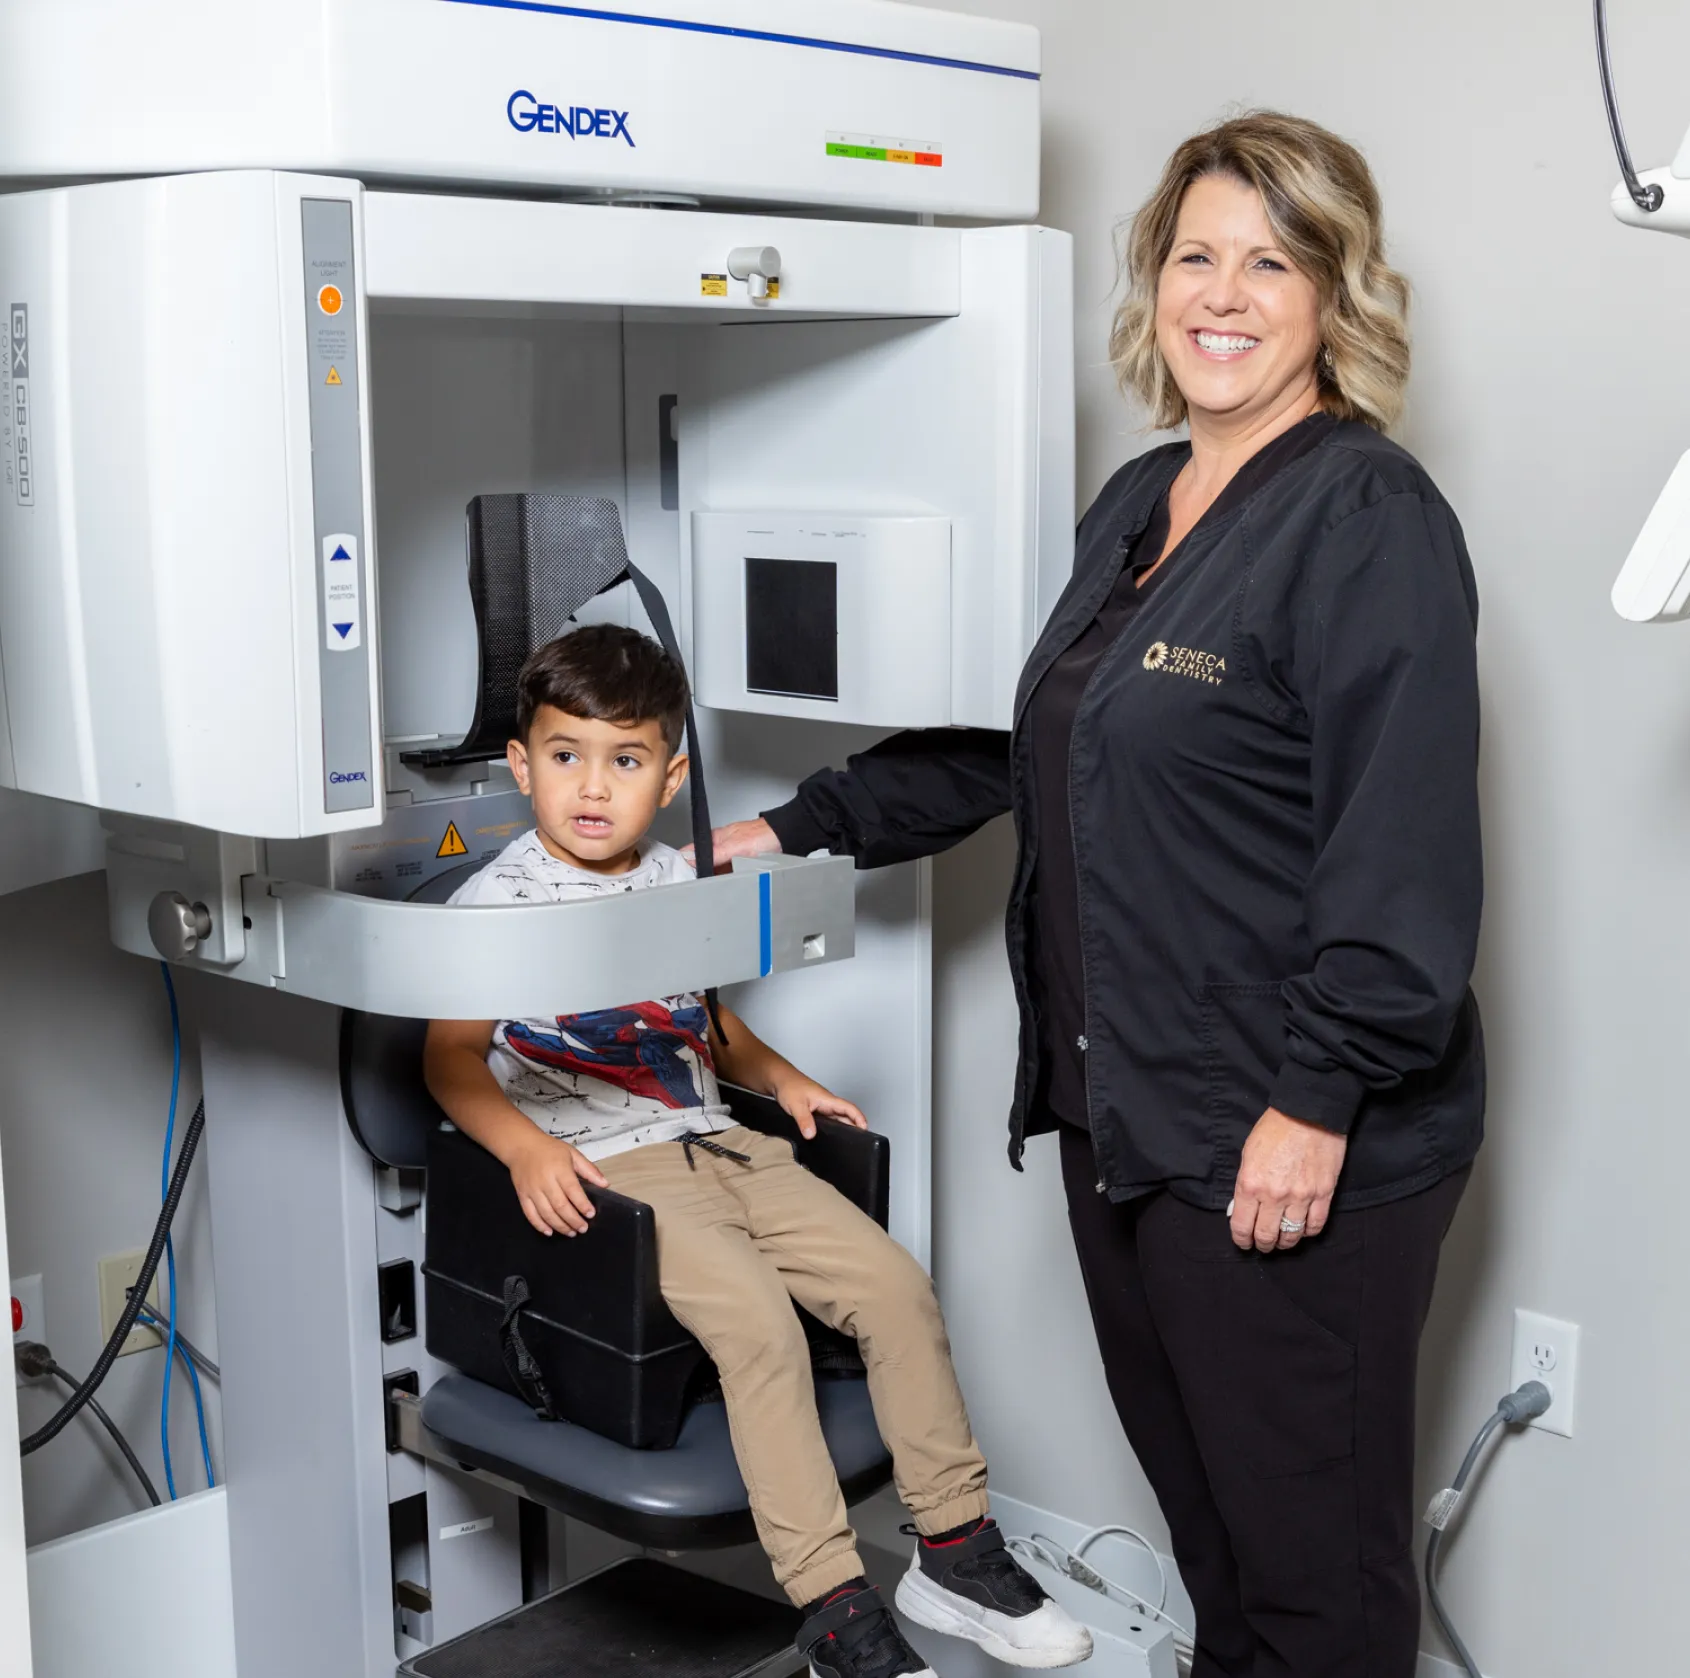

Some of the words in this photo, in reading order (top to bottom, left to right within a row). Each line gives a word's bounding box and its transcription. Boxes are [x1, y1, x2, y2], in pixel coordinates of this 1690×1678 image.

[507, 89, 636, 147] GENDEX
[12, 309, 27, 370] GX
[1, 322, 11, 418] POWERED
[3, 427, 12, 448] BY
[1170, 646, 1226, 671] SENECA
[1174, 659, 1214, 675] FAMILY
[1162, 664, 1223, 686] DENTISTRY
[330, 771, 367, 784] GENDEX
